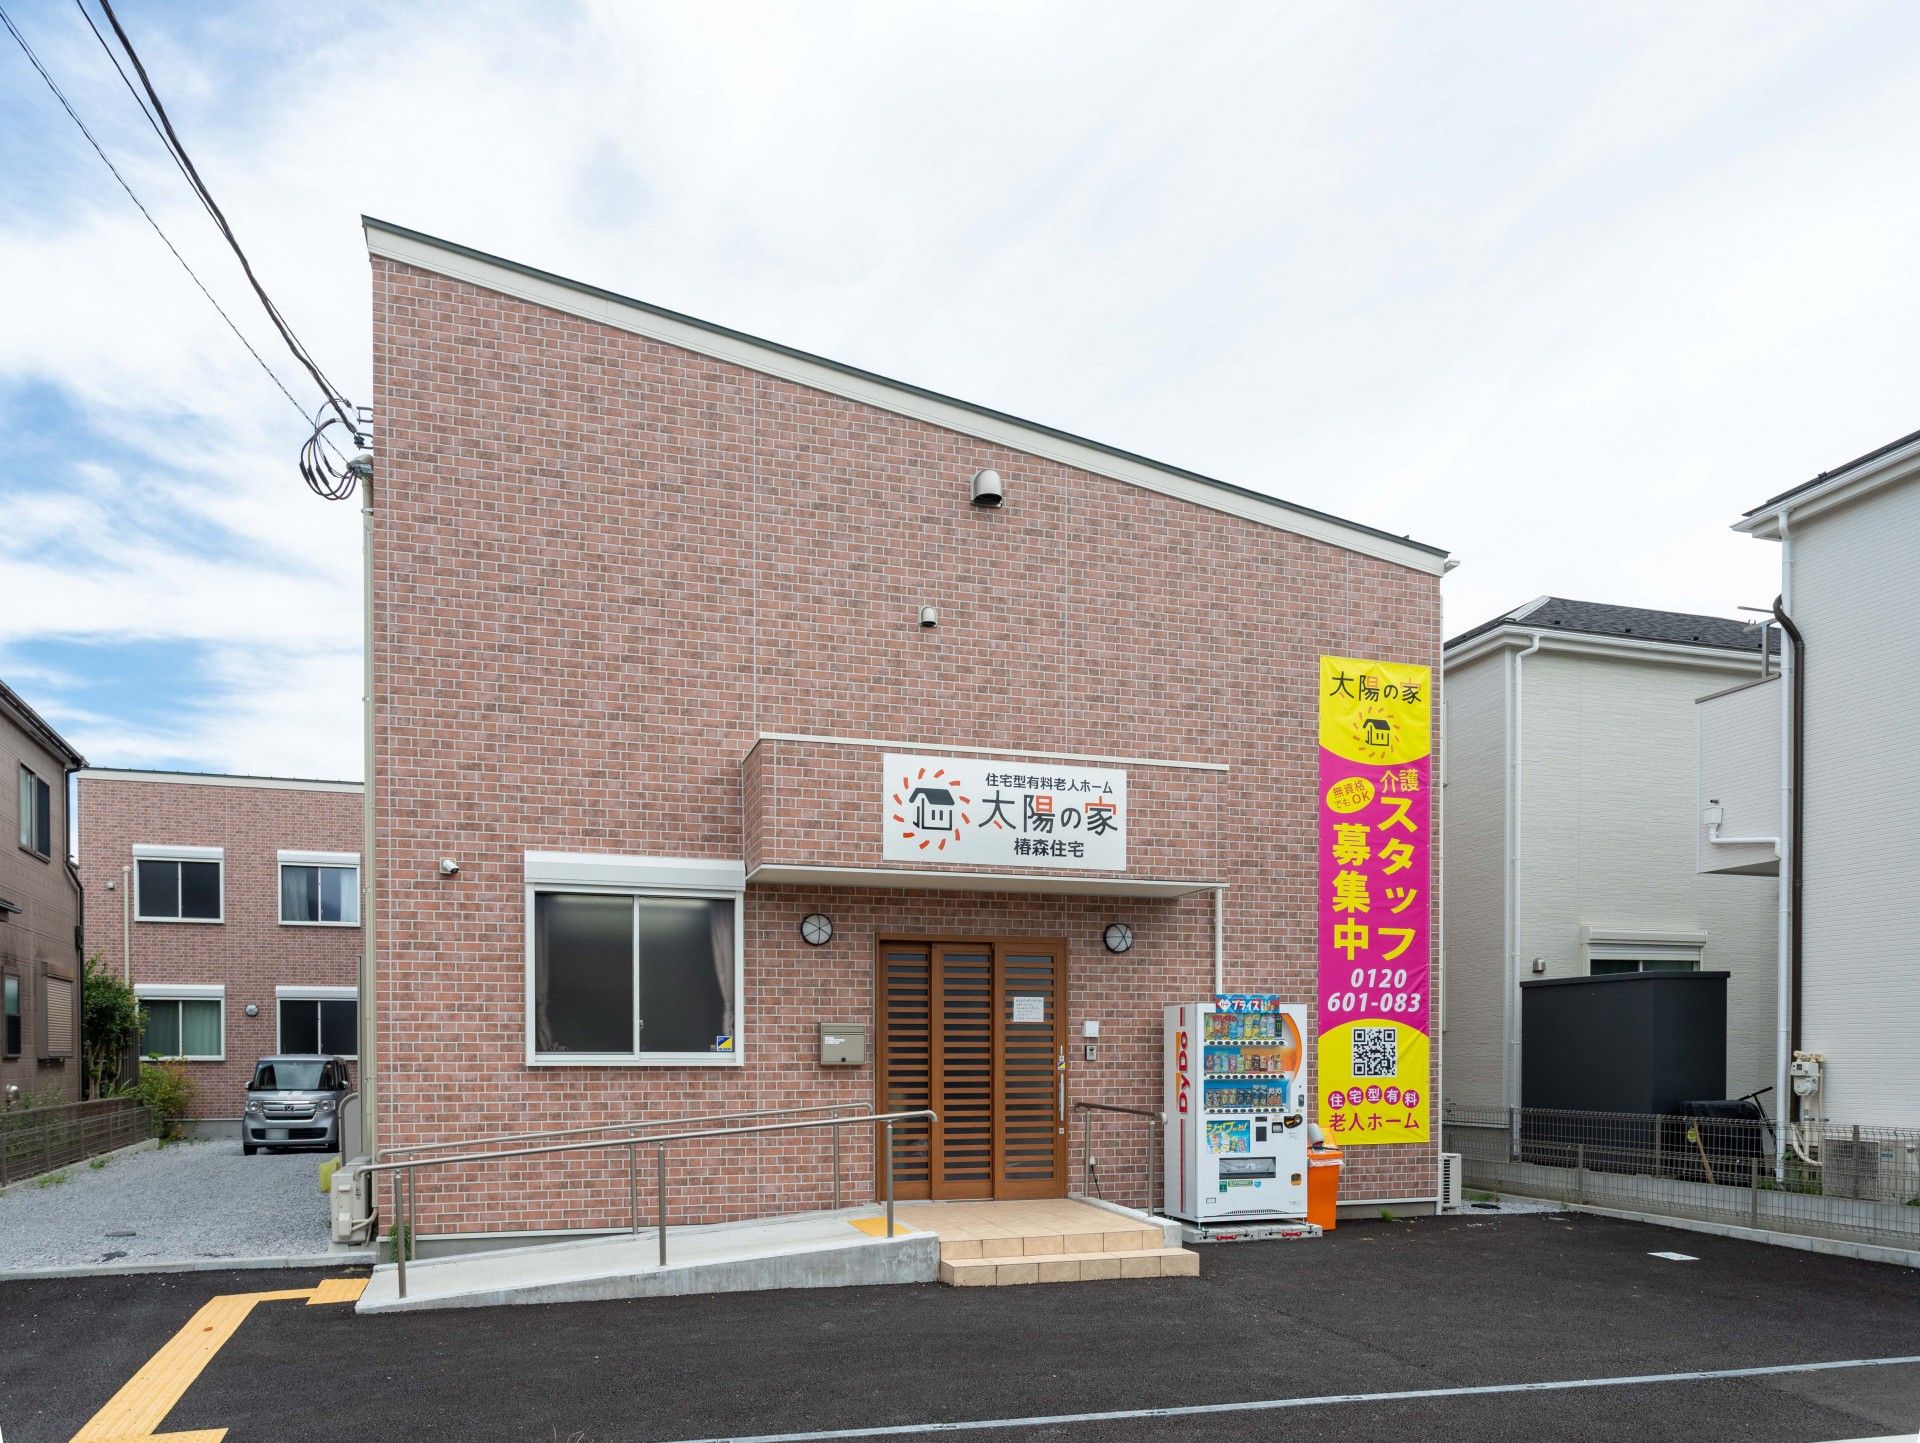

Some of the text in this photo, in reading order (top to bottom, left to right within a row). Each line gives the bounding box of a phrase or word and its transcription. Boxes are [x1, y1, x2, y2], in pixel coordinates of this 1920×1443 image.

[1330, 671, 1422, 704] 太陽の家
[985, 773, 1113, 794] 住宅型有料老人ホーム
[1333, 780, 1365, 799] 無資格
[1380, 769, 1419, 793] 介護
[978, 790, 1118, 836] 太陽の家
[1014, 838, 1084, 858] 椿森住宅
[1377, 796, 1418, 961] スタッフ
[1332, 822, 1371, 960] 募集中
[1350, 968, 1407, 989] 0120
[1327, 992, 1421, 1013] 601-083
[1329, 1087, 1419, 1109] 住宅型有料
[1329, 1112, 1420, 1133] 老人ホーム
